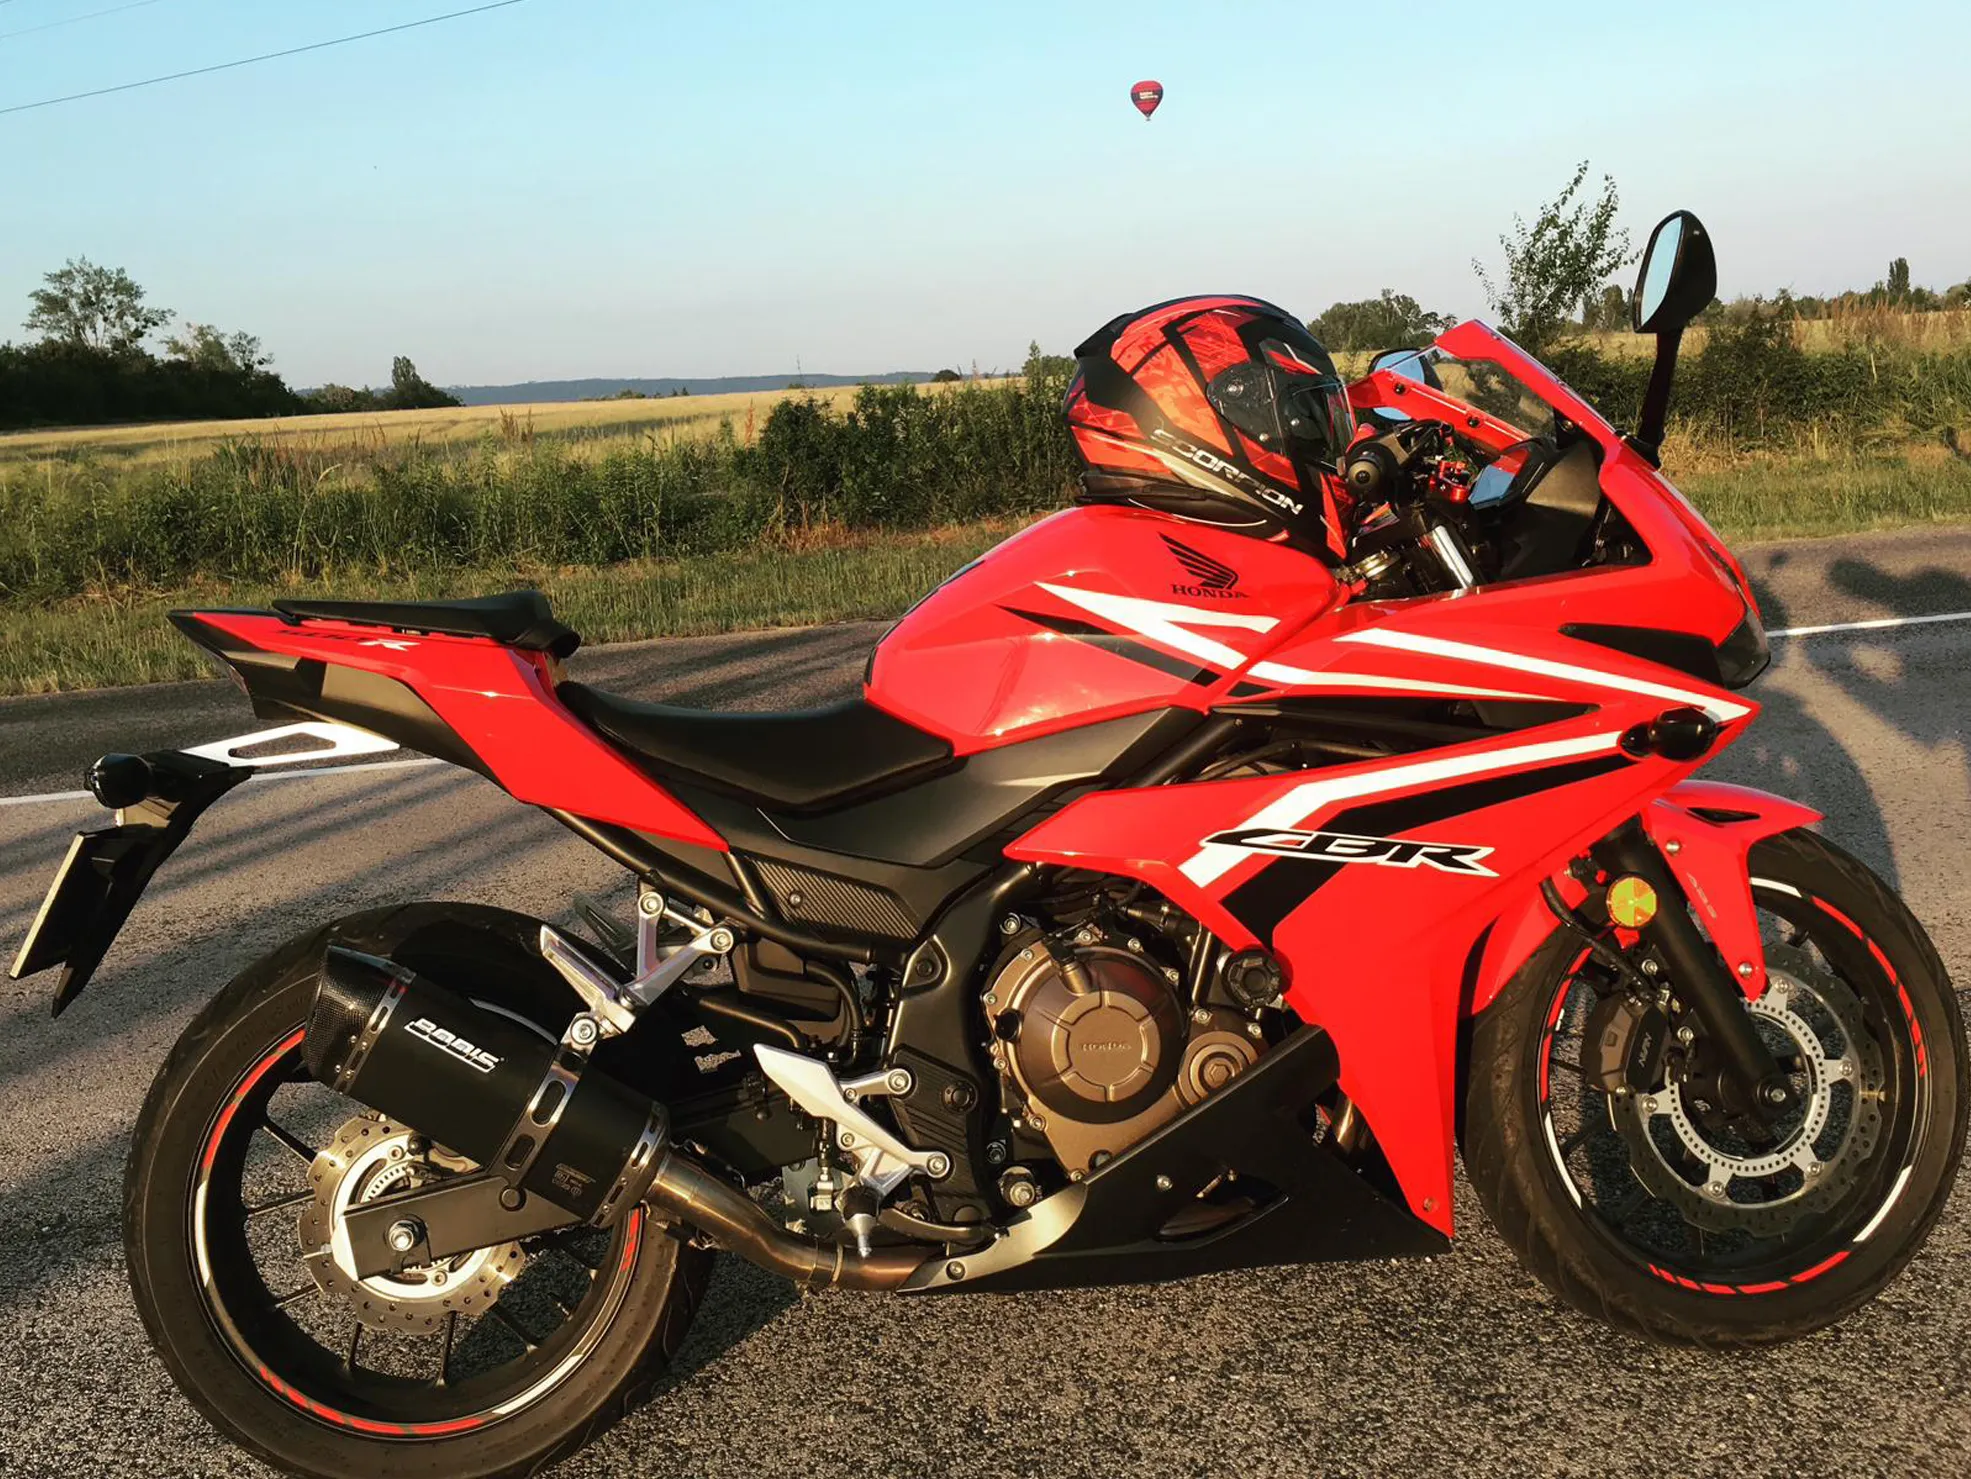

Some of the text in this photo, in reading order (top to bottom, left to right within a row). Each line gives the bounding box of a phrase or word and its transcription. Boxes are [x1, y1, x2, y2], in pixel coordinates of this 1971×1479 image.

[1150, 428, 1304, 515] SCORPION
[1171, 583, 1250, 599] HONDA
[1199, 828, 1501, 877] CBR
